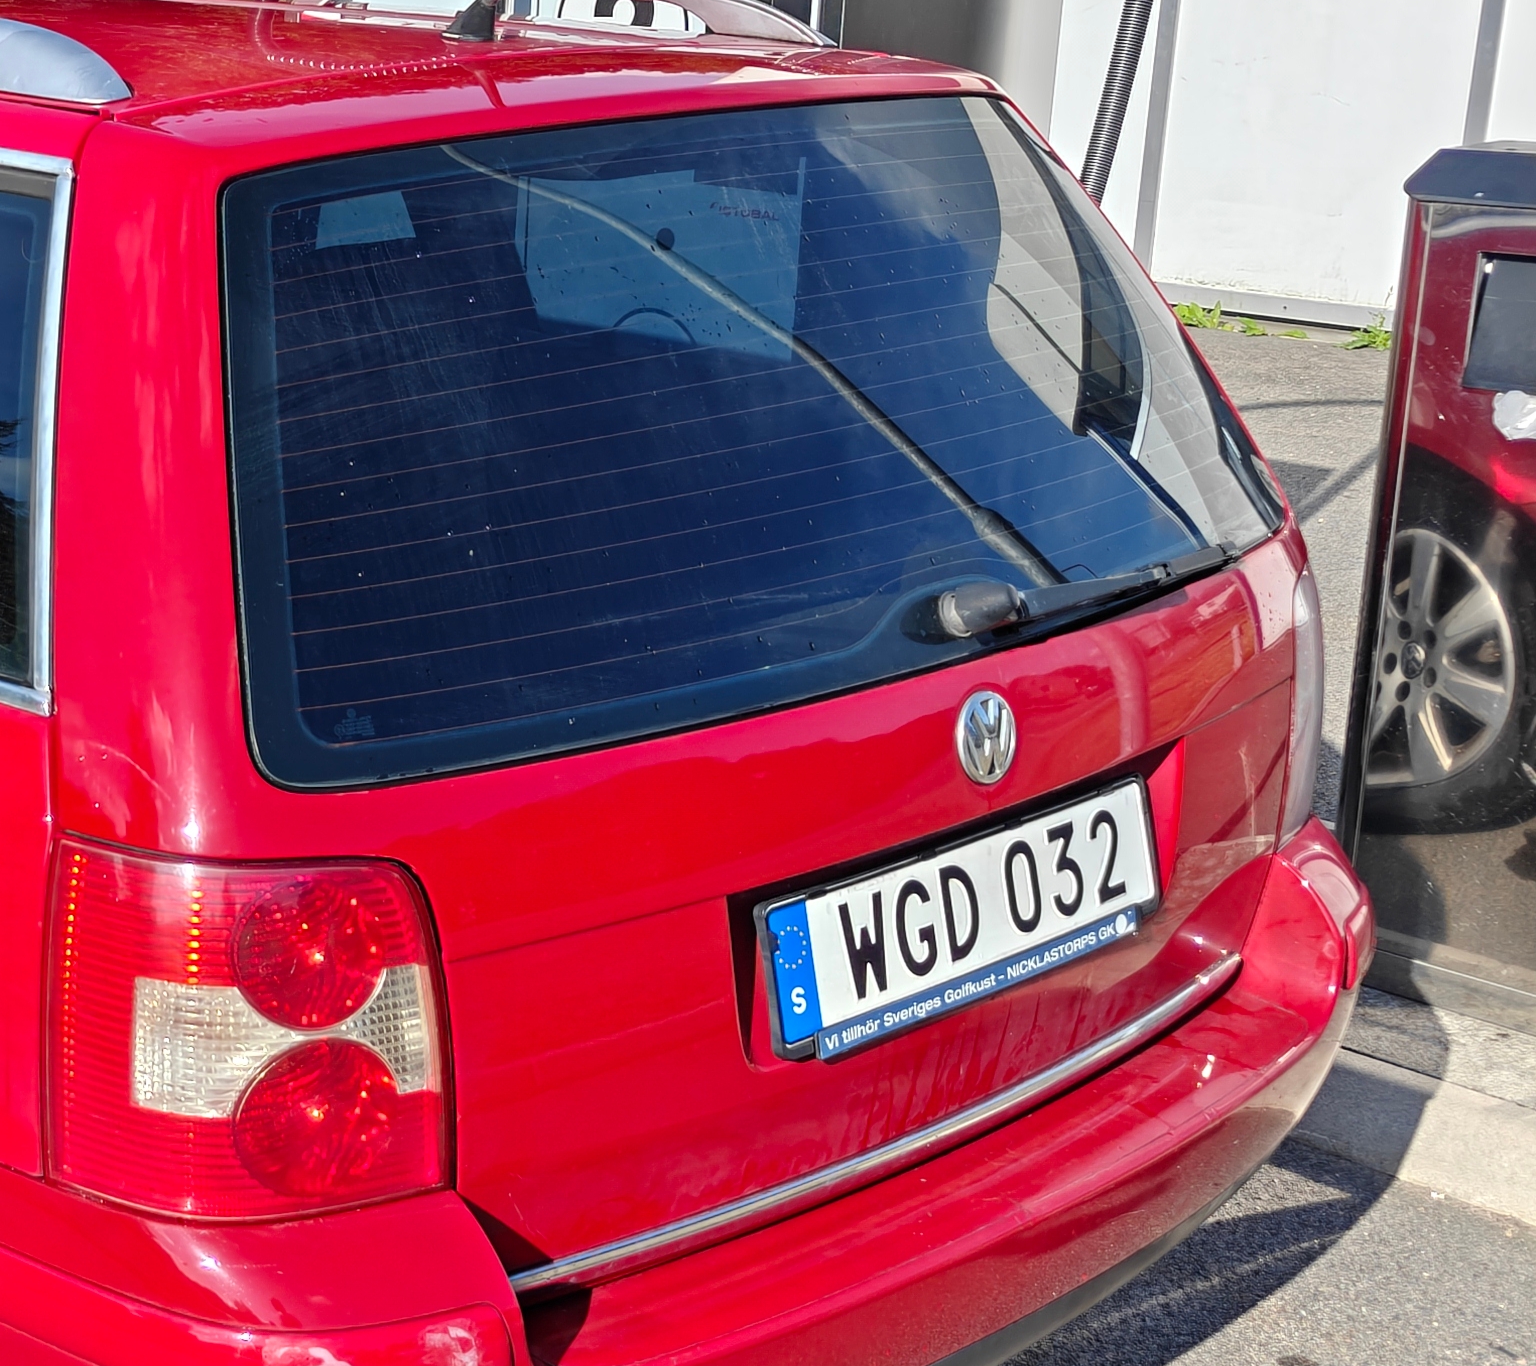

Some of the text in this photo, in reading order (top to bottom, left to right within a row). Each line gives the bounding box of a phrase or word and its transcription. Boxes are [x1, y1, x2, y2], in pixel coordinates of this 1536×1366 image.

[838, 809, 1127, 1001] WGD 032
[791, 986, 807, 1015] S
[824, 1033, 839, 1051] Vi
[841, 1018, 881, 1045] tillhör
[883, 996, 942, 1027] Sveriges
[944, 972, 997, 1004] Golfkust
[1006, 932, 1096, 980] NICKLASTORPS
[1097, 923, 1115, 941] GK
